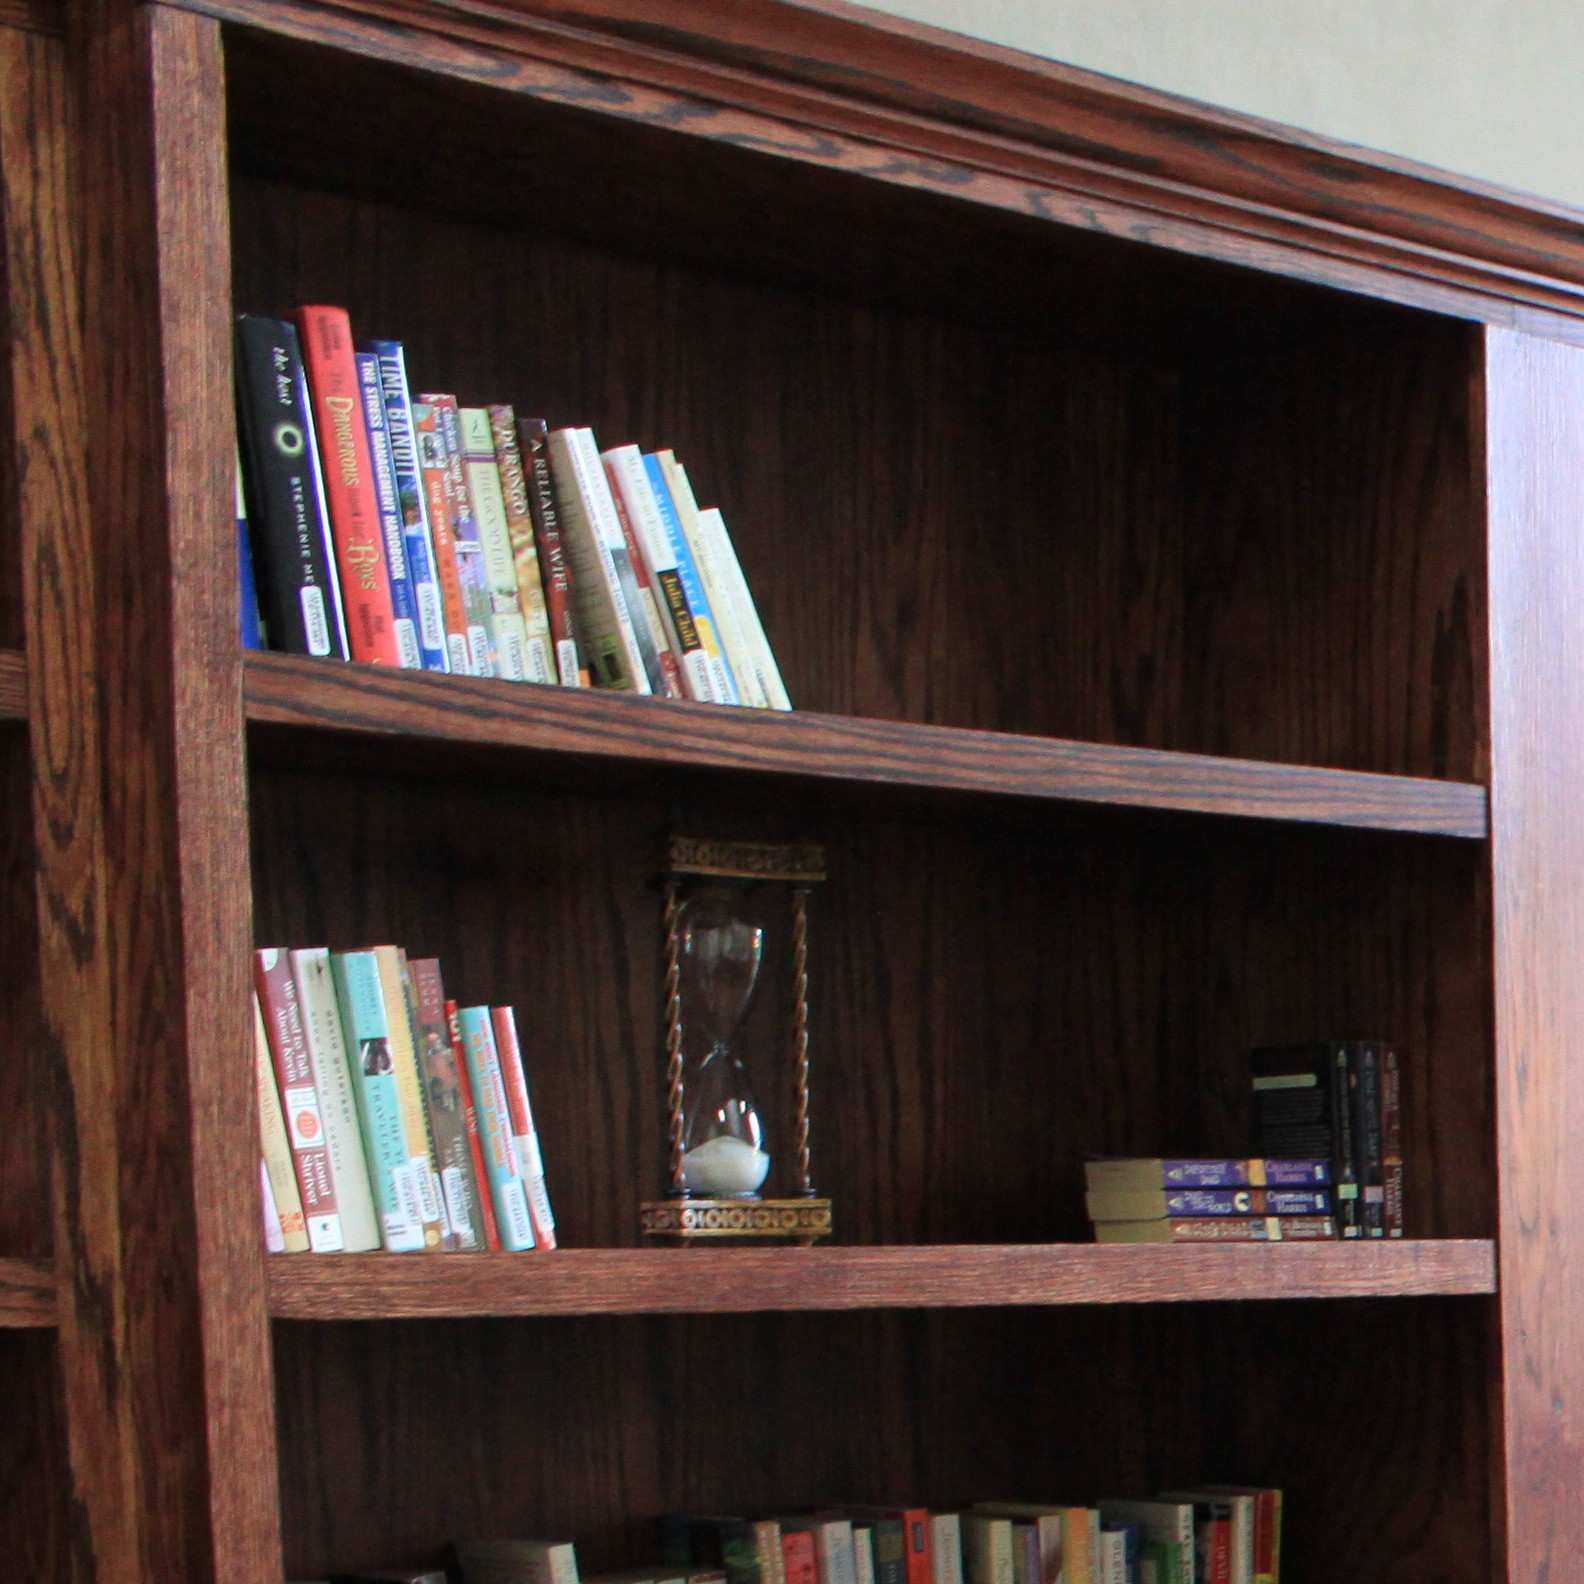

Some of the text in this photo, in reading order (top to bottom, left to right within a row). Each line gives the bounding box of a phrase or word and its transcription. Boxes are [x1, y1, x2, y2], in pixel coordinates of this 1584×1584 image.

[327, 393, 358, 488] DANGEROUS
[378, 354, 414, 479] TIME BANDIT
[443, 405, 459, 448] Chicken
[451, 453, 464, 486] Soup
[361, 360, 404, 580] THE STRESS MANAGEMENT HANDBOOK
[502, 428, 527, 513] DURANGO
[290, 476, 311, 558] STEPHENIE
[531, 438, 567, 593] A RELIABLE WIFE
[662, 573, 697, 649] Julia Child
[284, 980, 294, 999] We
[287, 1002, 300, 1032] Need
[276, 1006, 298, 1082] About Kevin
[296, 1052, 308, 1077] Talk
[302, 1153, 319, 1205] Shriver
[314, 1152, 329, 1196] Lionel
